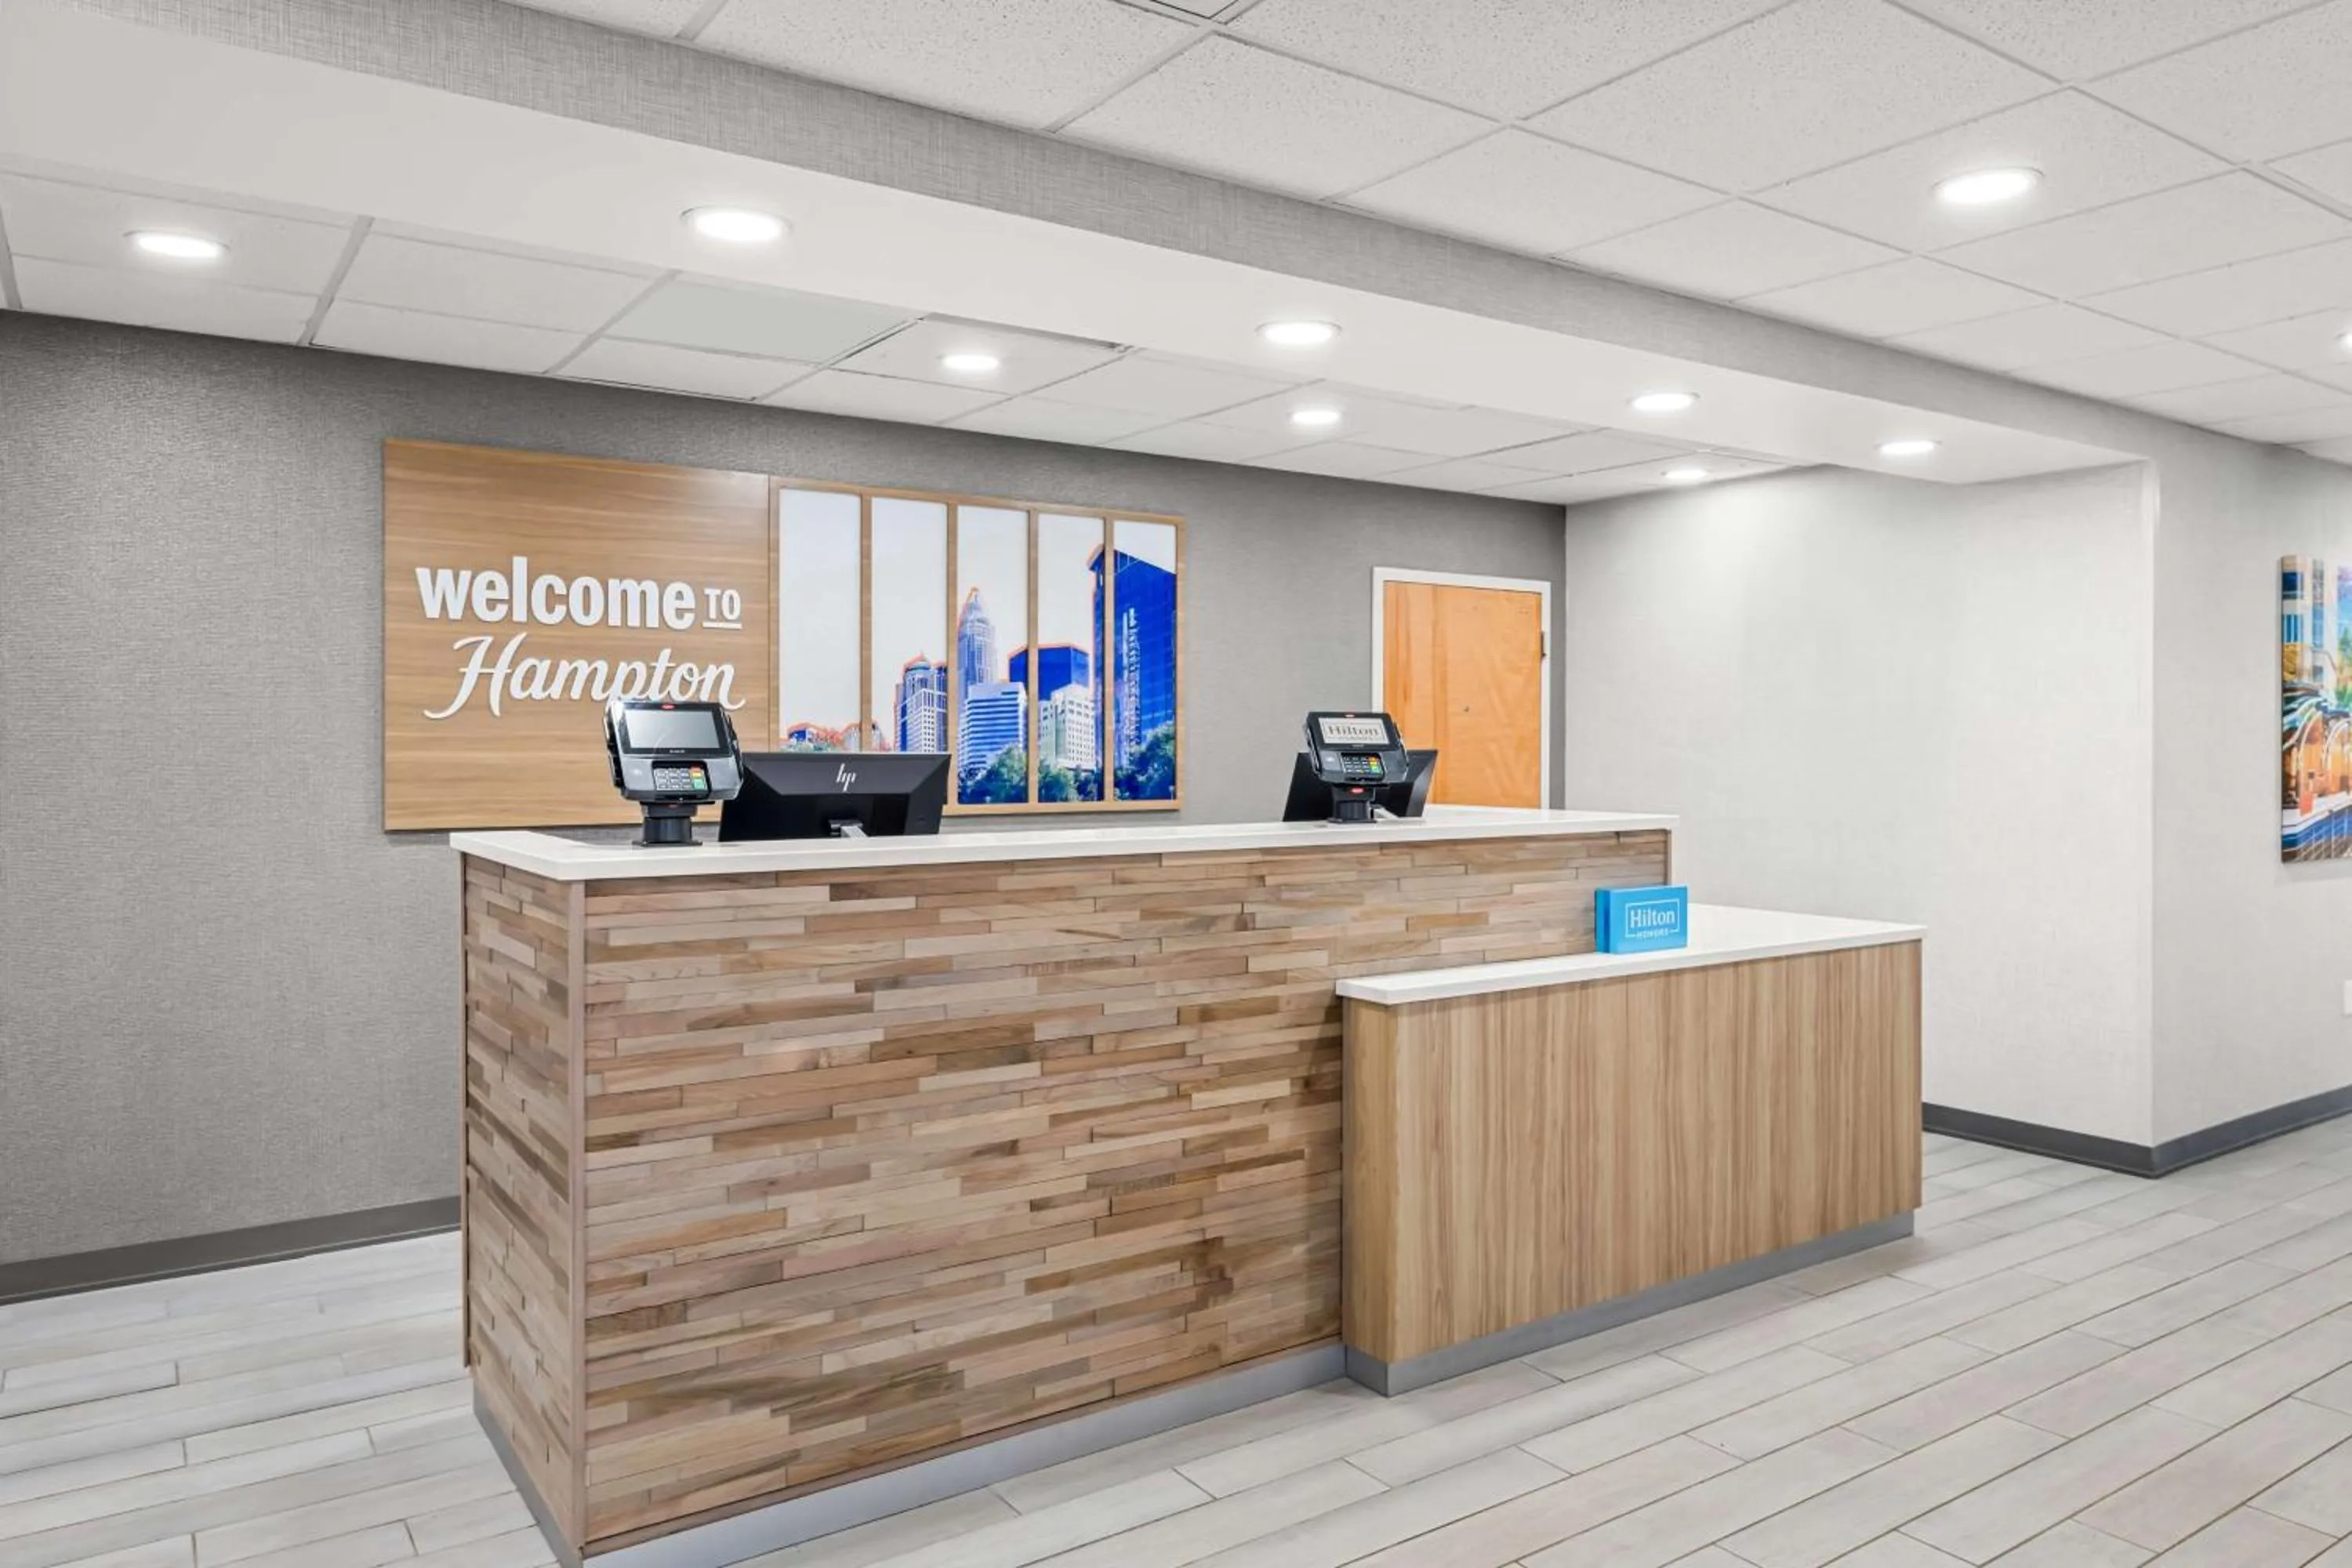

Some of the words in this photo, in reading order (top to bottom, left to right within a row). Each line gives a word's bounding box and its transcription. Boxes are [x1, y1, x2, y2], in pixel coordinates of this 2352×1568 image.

[415, 556, 696, 630] welcome
[703, 586, 742, 621] TO
[423, 632, 746, 720] Hampton
[1327, 725, 1380, 735] Hilton
[836, 763, 858, 792] hp
[1630, 907, 1675, 928] Hilton
